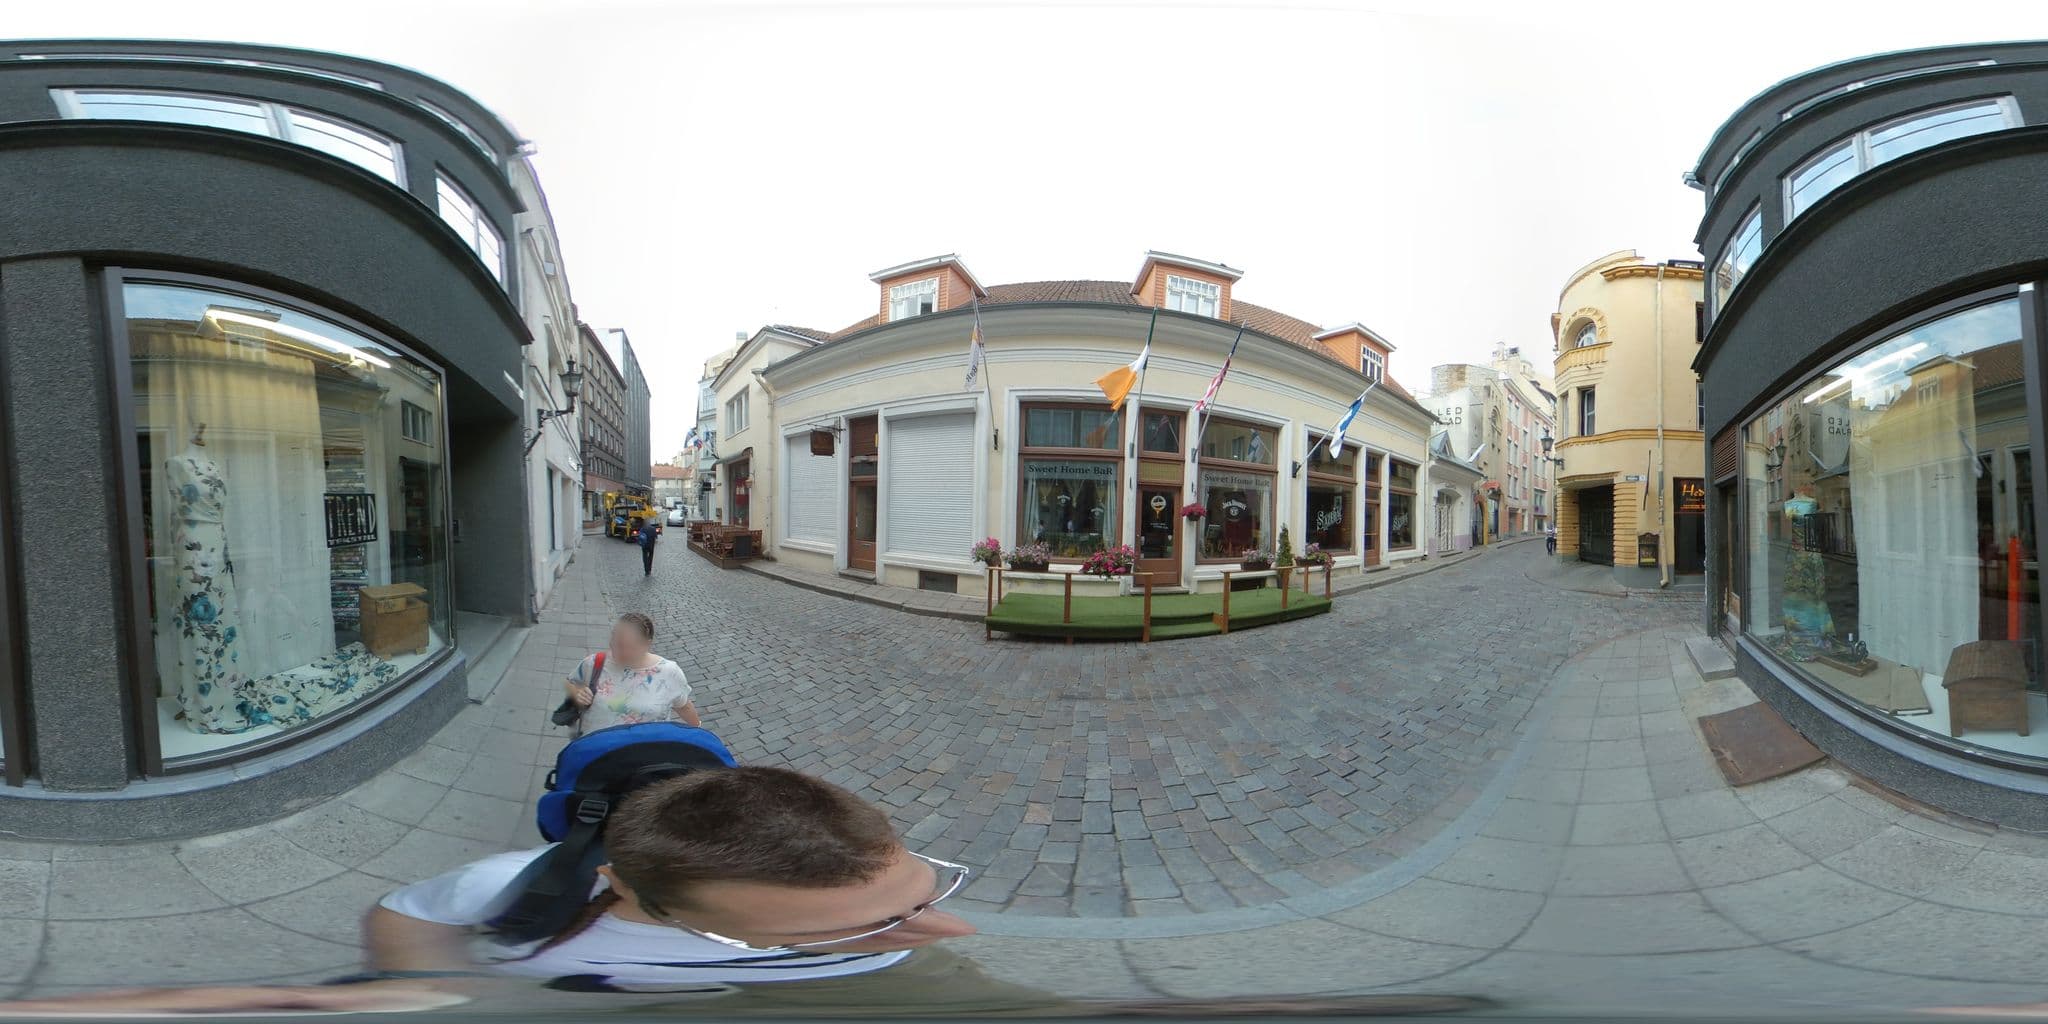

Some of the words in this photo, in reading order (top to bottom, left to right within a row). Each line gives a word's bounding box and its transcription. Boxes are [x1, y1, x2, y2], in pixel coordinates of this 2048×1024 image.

[1028, 465, 1058, 473] Sweet
[1061, 465, 1090, 474] Home
[1205, 474, 1229, 483] Sweet
[1231, 476, 1254, 485] Home
[324, 495, 376, 537] TREND
